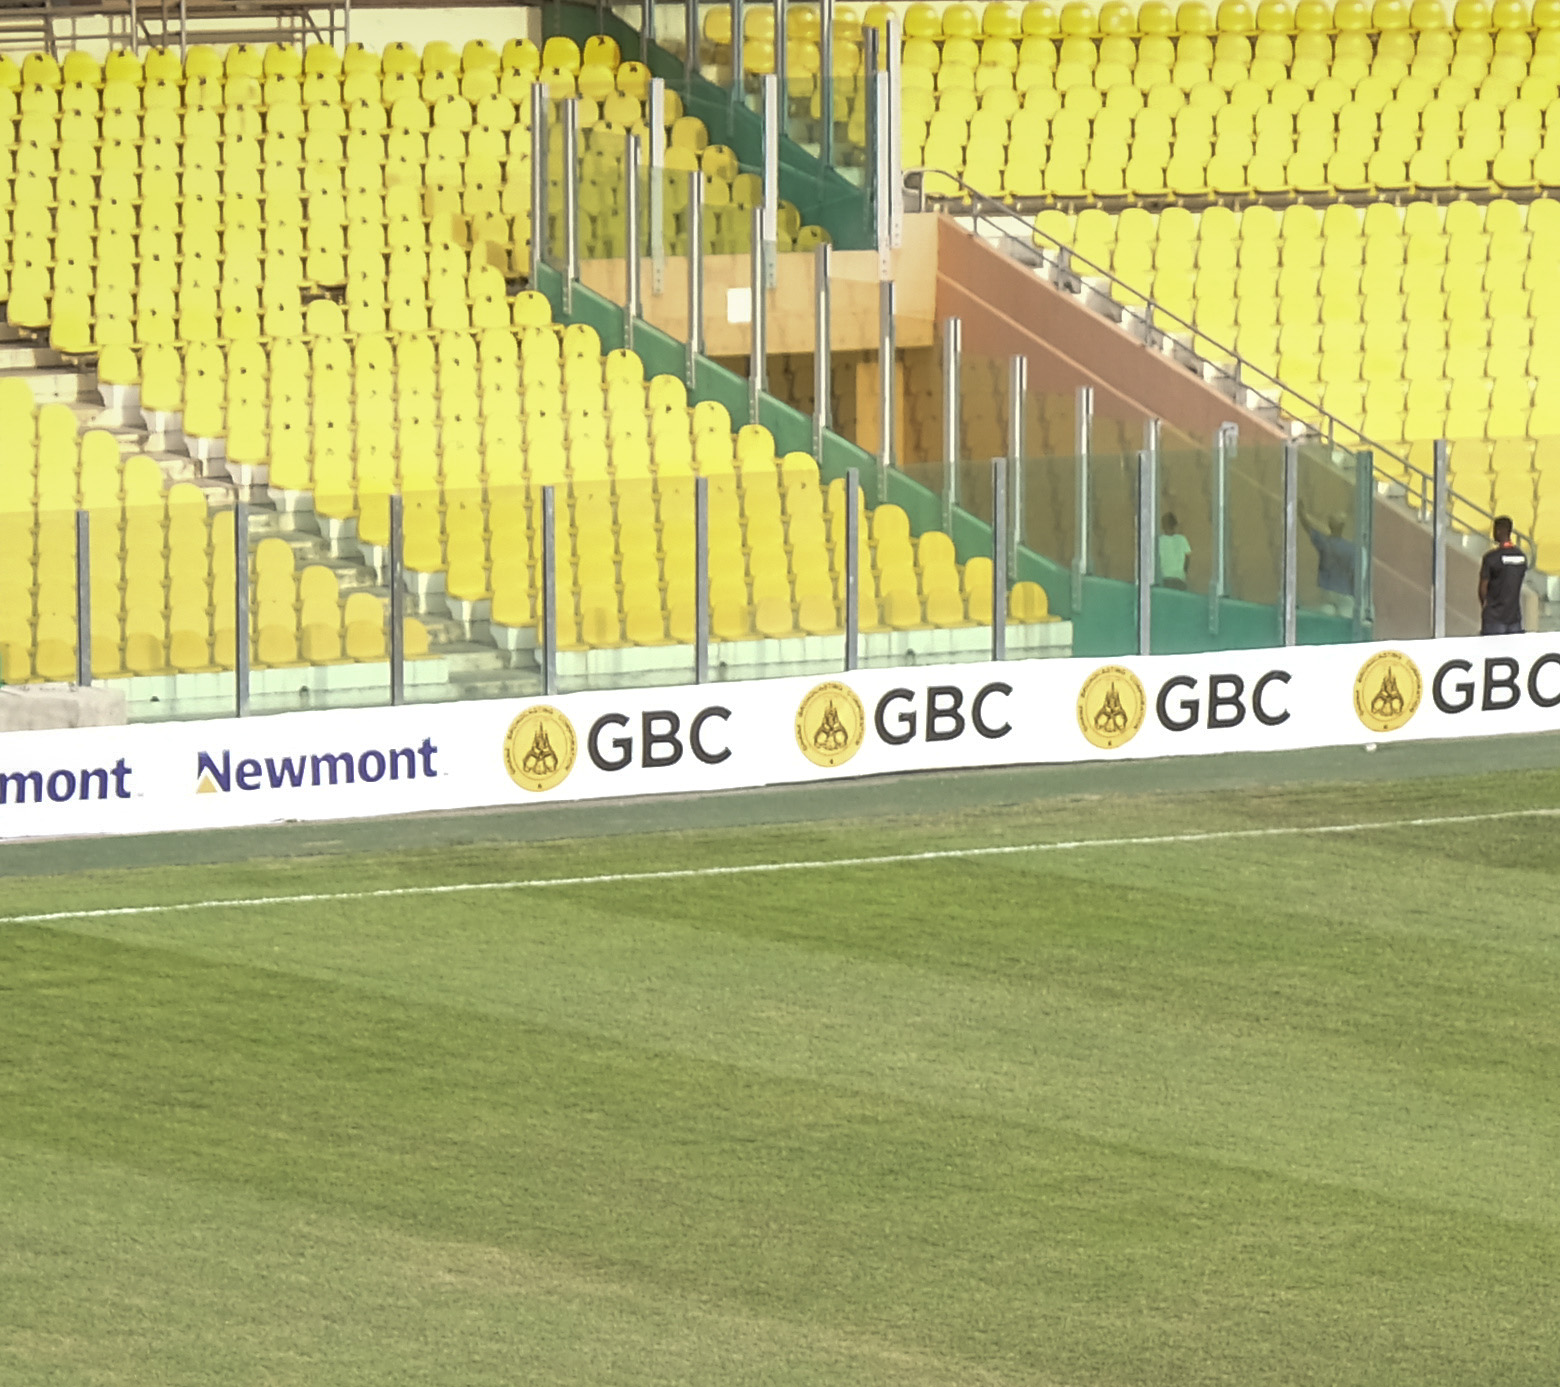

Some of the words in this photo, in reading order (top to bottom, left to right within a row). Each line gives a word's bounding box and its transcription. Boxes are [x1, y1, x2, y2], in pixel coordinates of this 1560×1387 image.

[874, 681, 1013, 746] GBC
[1155, 669, 1292, 731] GBC
[197, 736, 438, 793] Newmont
[587, 705, 732, 772] GBC
